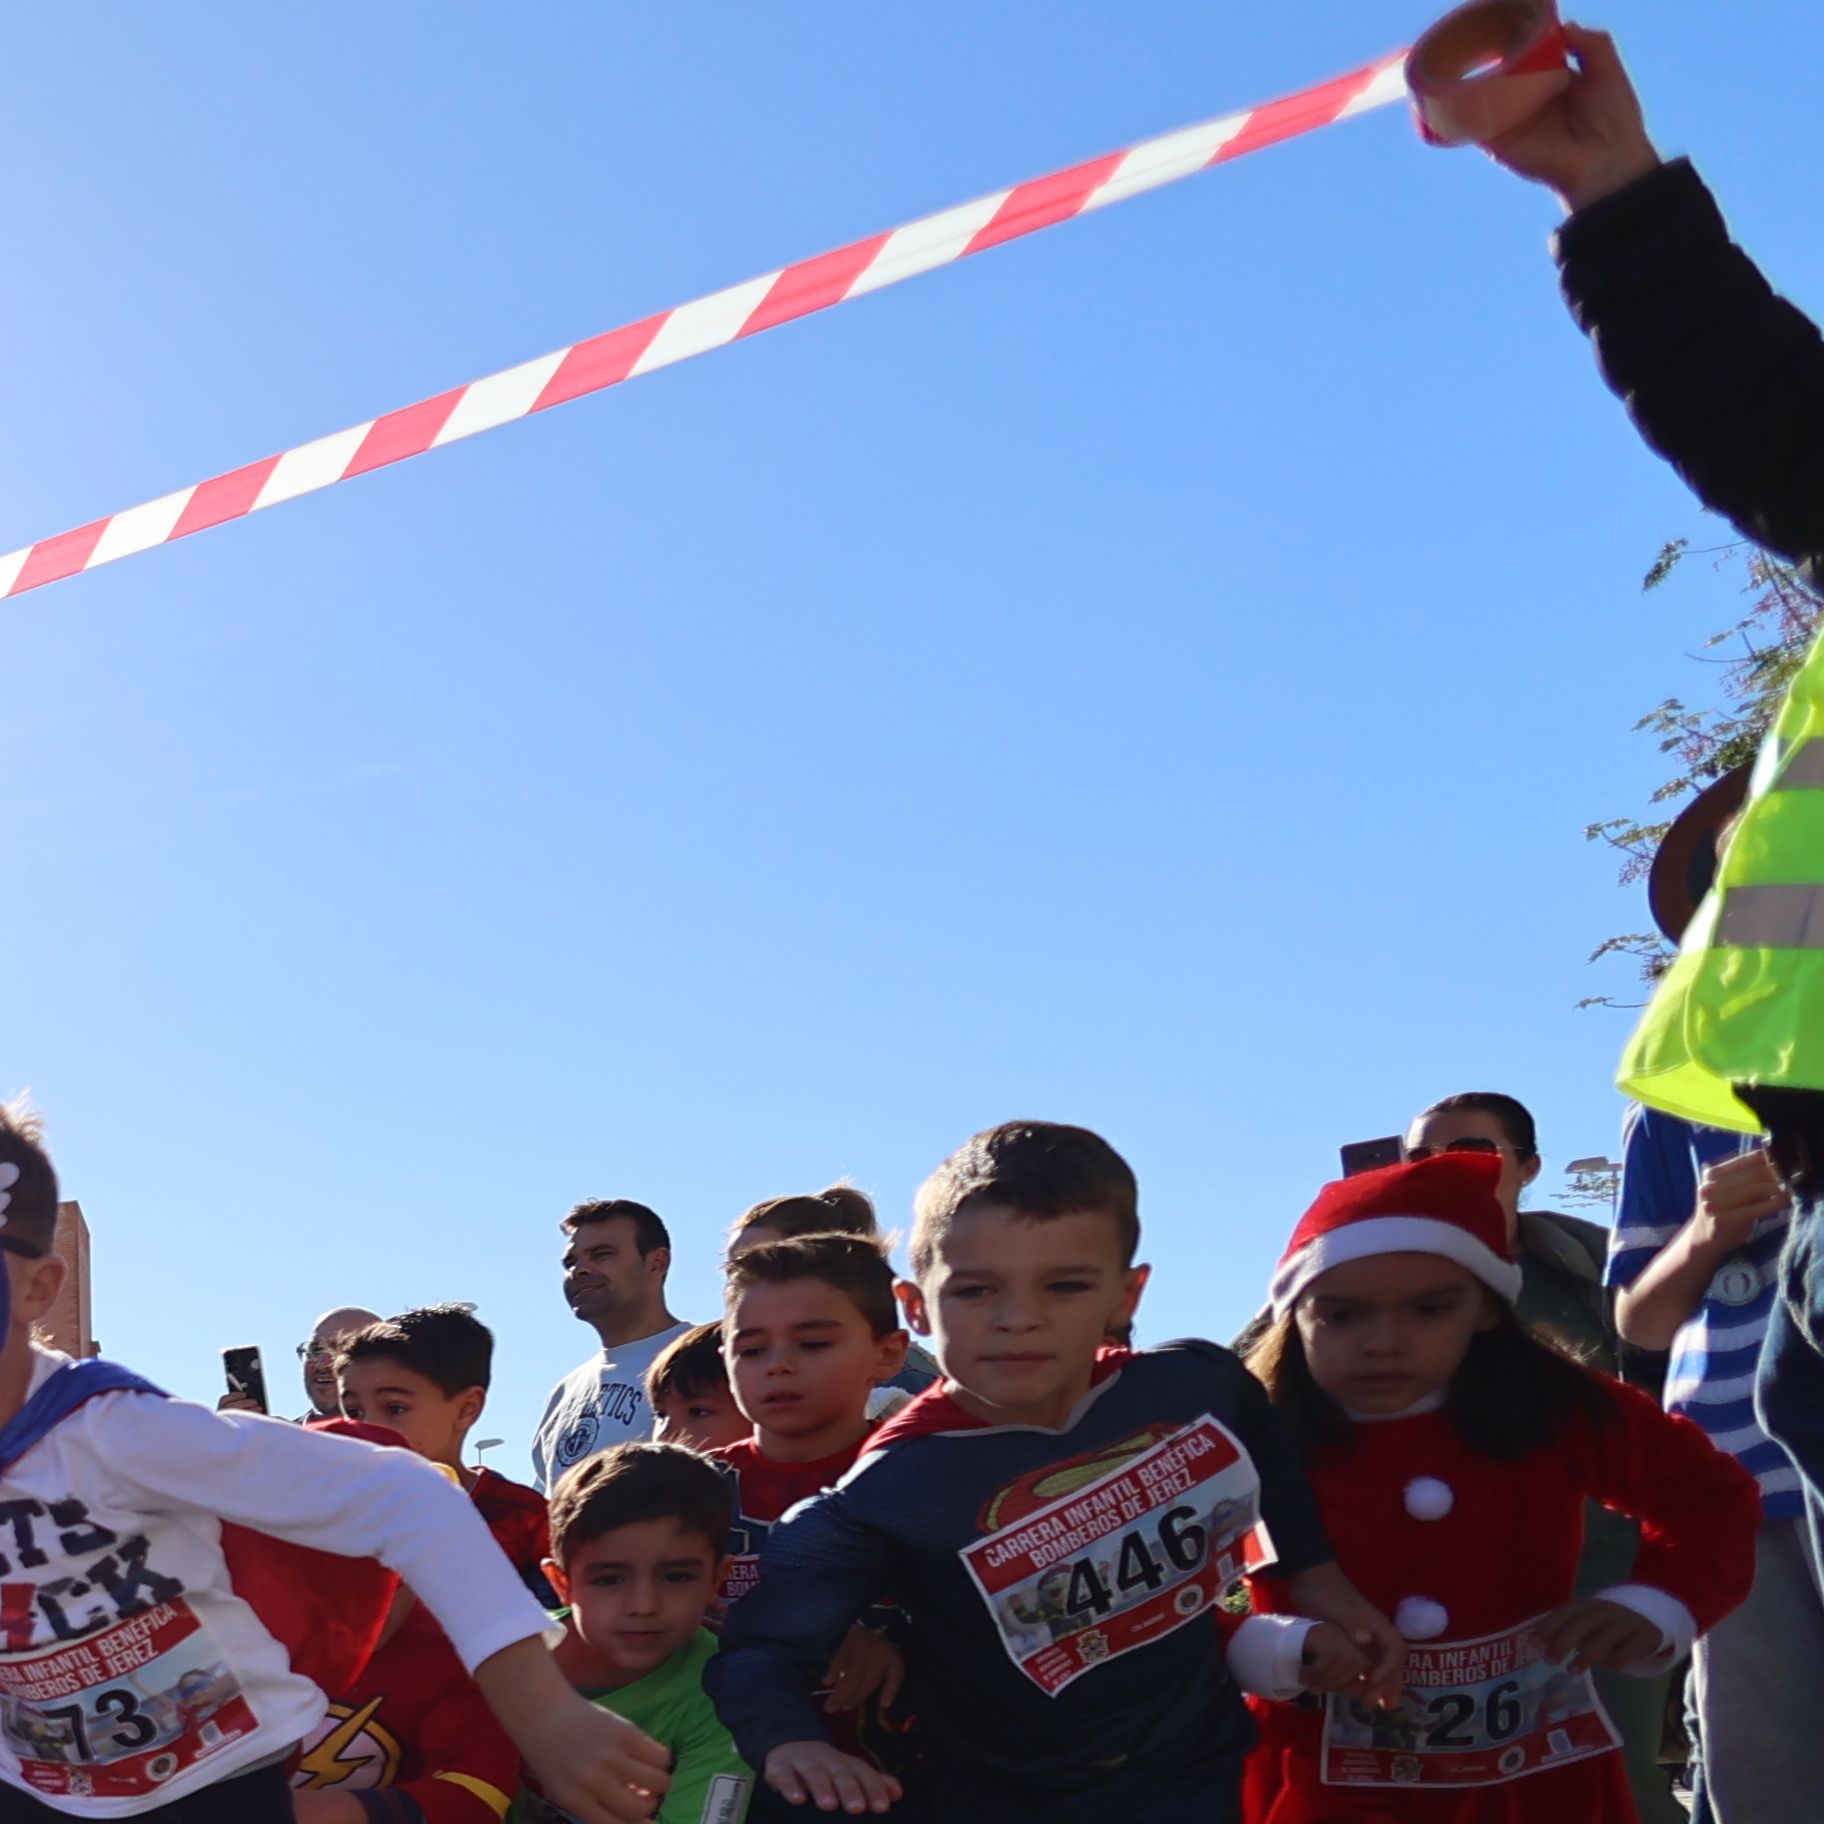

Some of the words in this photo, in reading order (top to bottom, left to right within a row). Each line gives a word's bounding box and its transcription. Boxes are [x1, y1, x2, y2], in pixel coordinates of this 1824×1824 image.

[985, 1516, 1068, 1568] CARRERA
[1065, 1480, 1141, 1528] INFANTIL
[1136, 1433, 1216, 1486] BENÉFICA
[1028, 1514, 1121, 1570] BOMBEROS
[1121, 1499, 1148, 1522] DE
[1143, 1472, 1196, 1509] JEREZ
[1066, 1505, 1208, 1618] 446
[24, 1645, 102, 1682] INFANTIL
[96, 1603, 179, 1655] BENÉFICA
[80, 1665, 106, 1684] DE
[107, 1638, 160, 1678] JEREZ
[1403, 1666, 1488, 1687] OMBEROS
[1490, 1658, 1510, 1678] DE
[1439, 1640, 1511, 1668] INFANTIL
[43, 1688, 159, 1761] 73
[1425, 1680, 1521, 1747] 26
